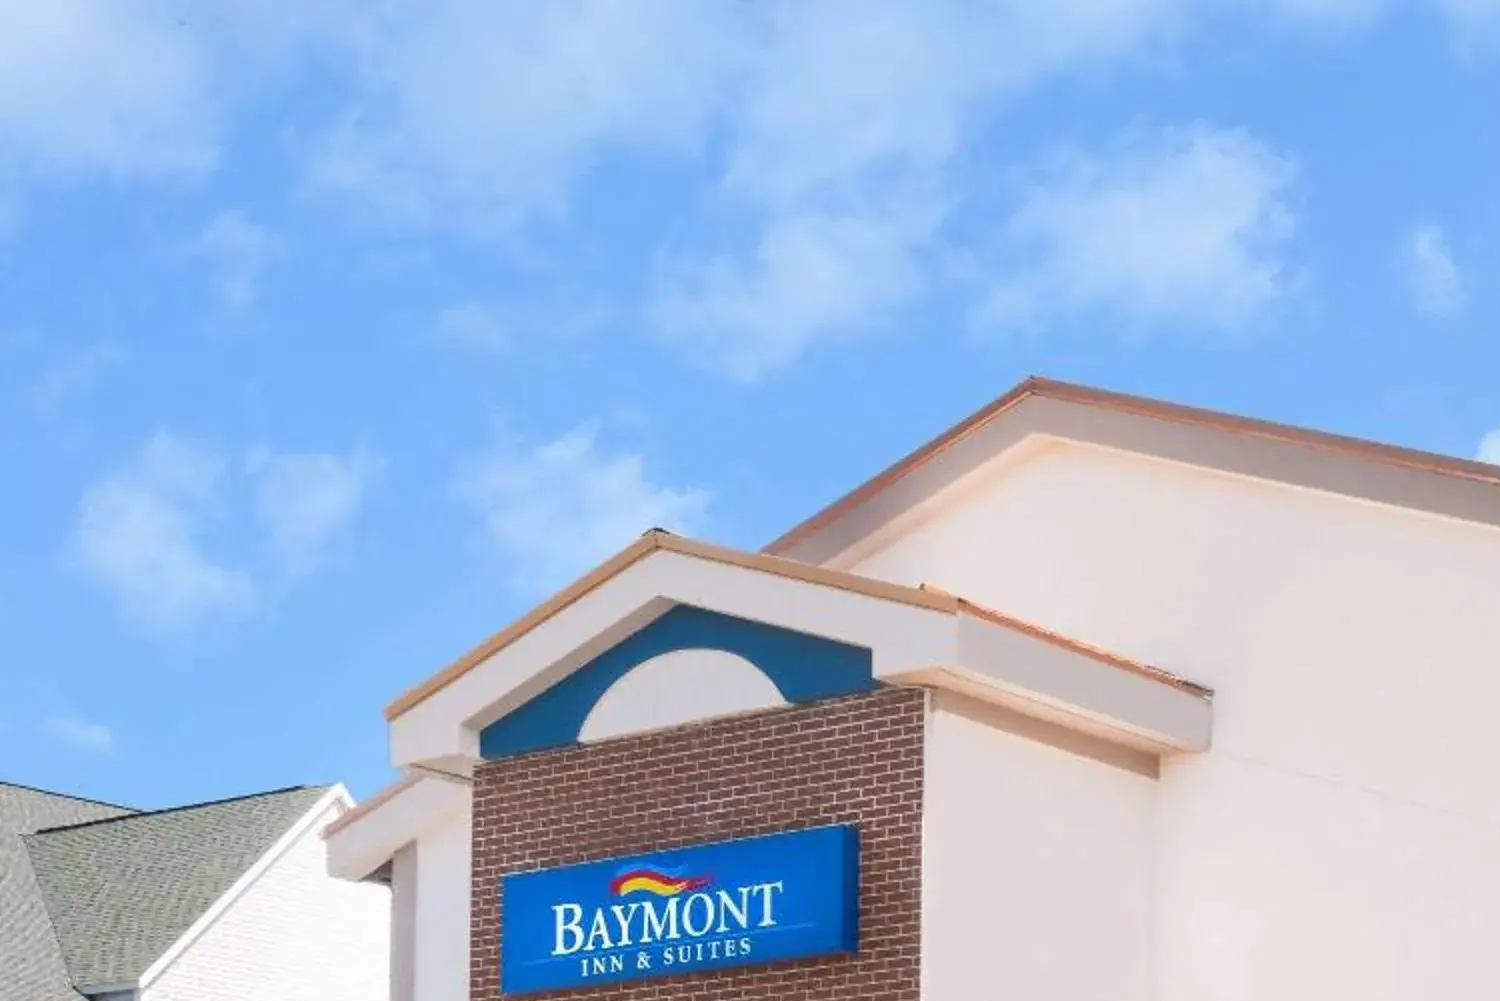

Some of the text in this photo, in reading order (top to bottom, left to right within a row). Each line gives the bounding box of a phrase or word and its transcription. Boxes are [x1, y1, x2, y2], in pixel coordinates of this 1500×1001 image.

[551, 880, 783, 956] BAYMONT
[581, 938, 751, 977] INN & SUITES
